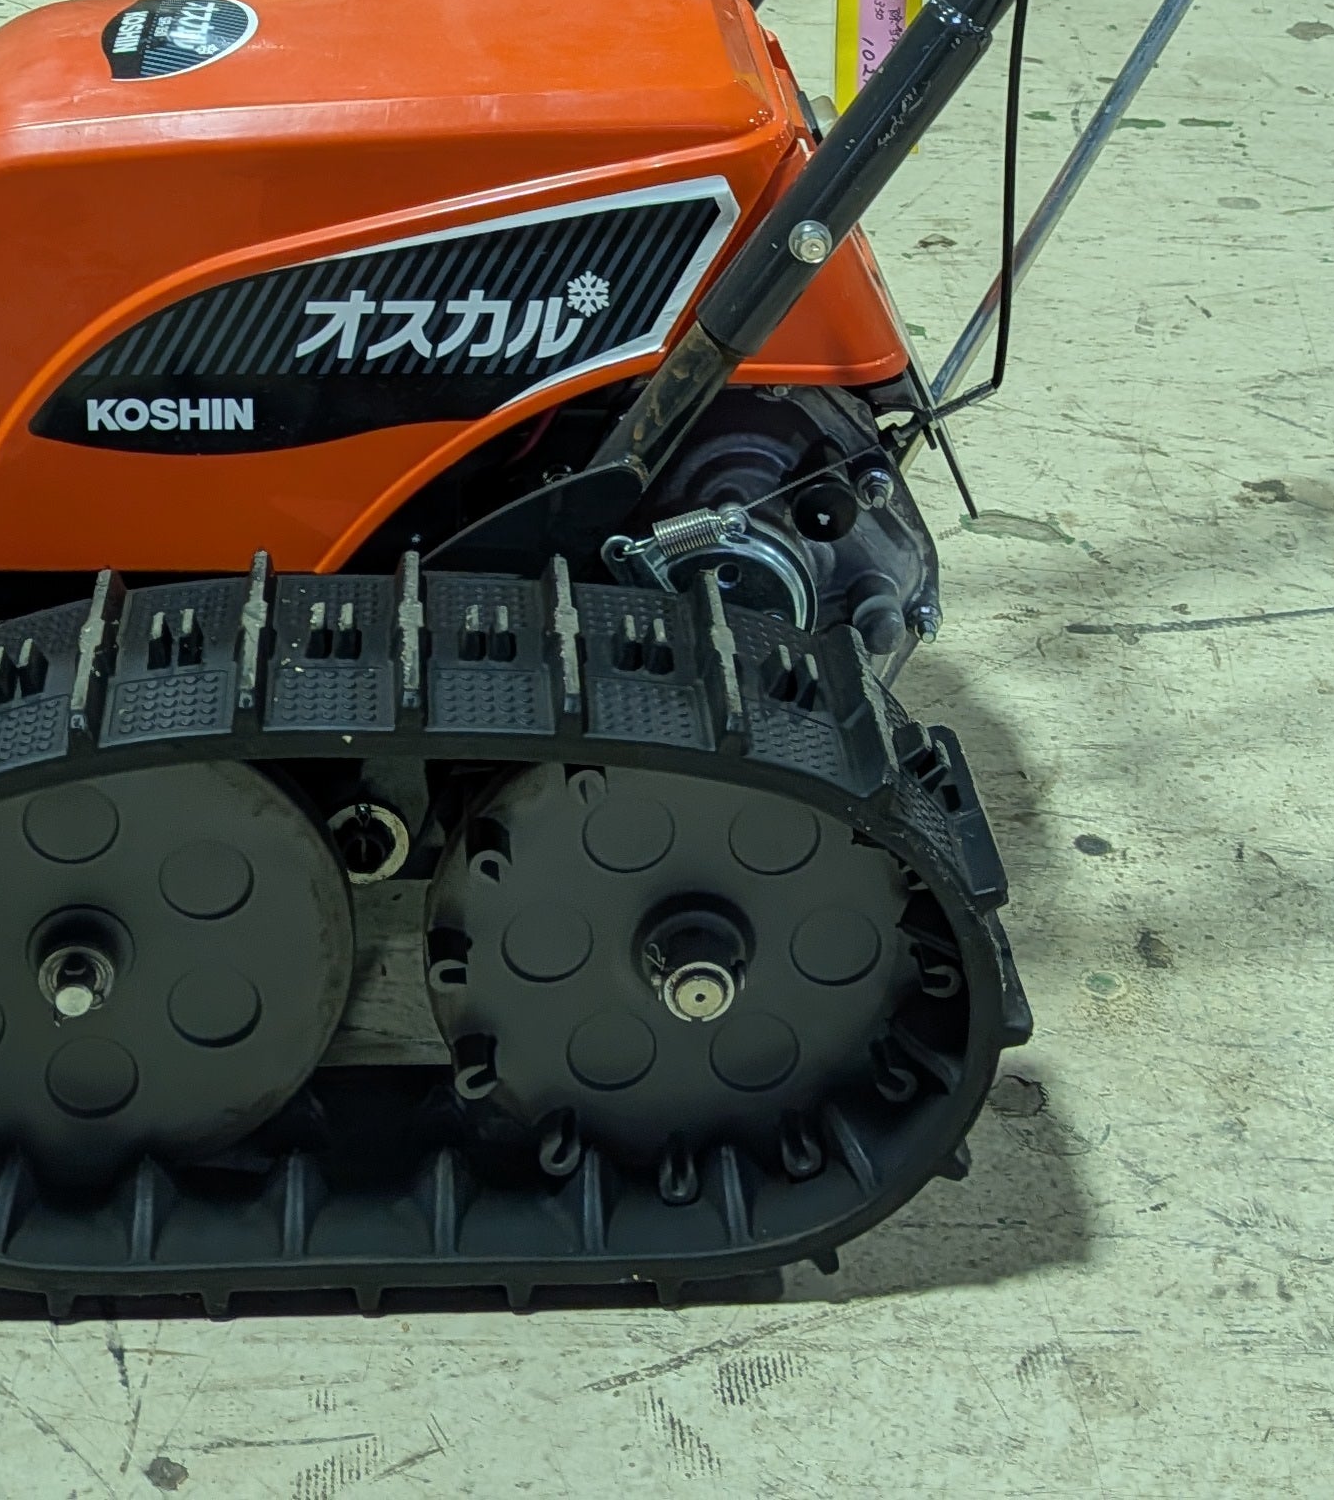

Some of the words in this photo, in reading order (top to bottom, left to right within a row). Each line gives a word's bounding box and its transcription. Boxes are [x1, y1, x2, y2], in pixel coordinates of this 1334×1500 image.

[112, 10, 150, 54] KOSHIN
[294, 289, 581, 360] オスカル
[86, 397, 254, 432] KOSHIN
